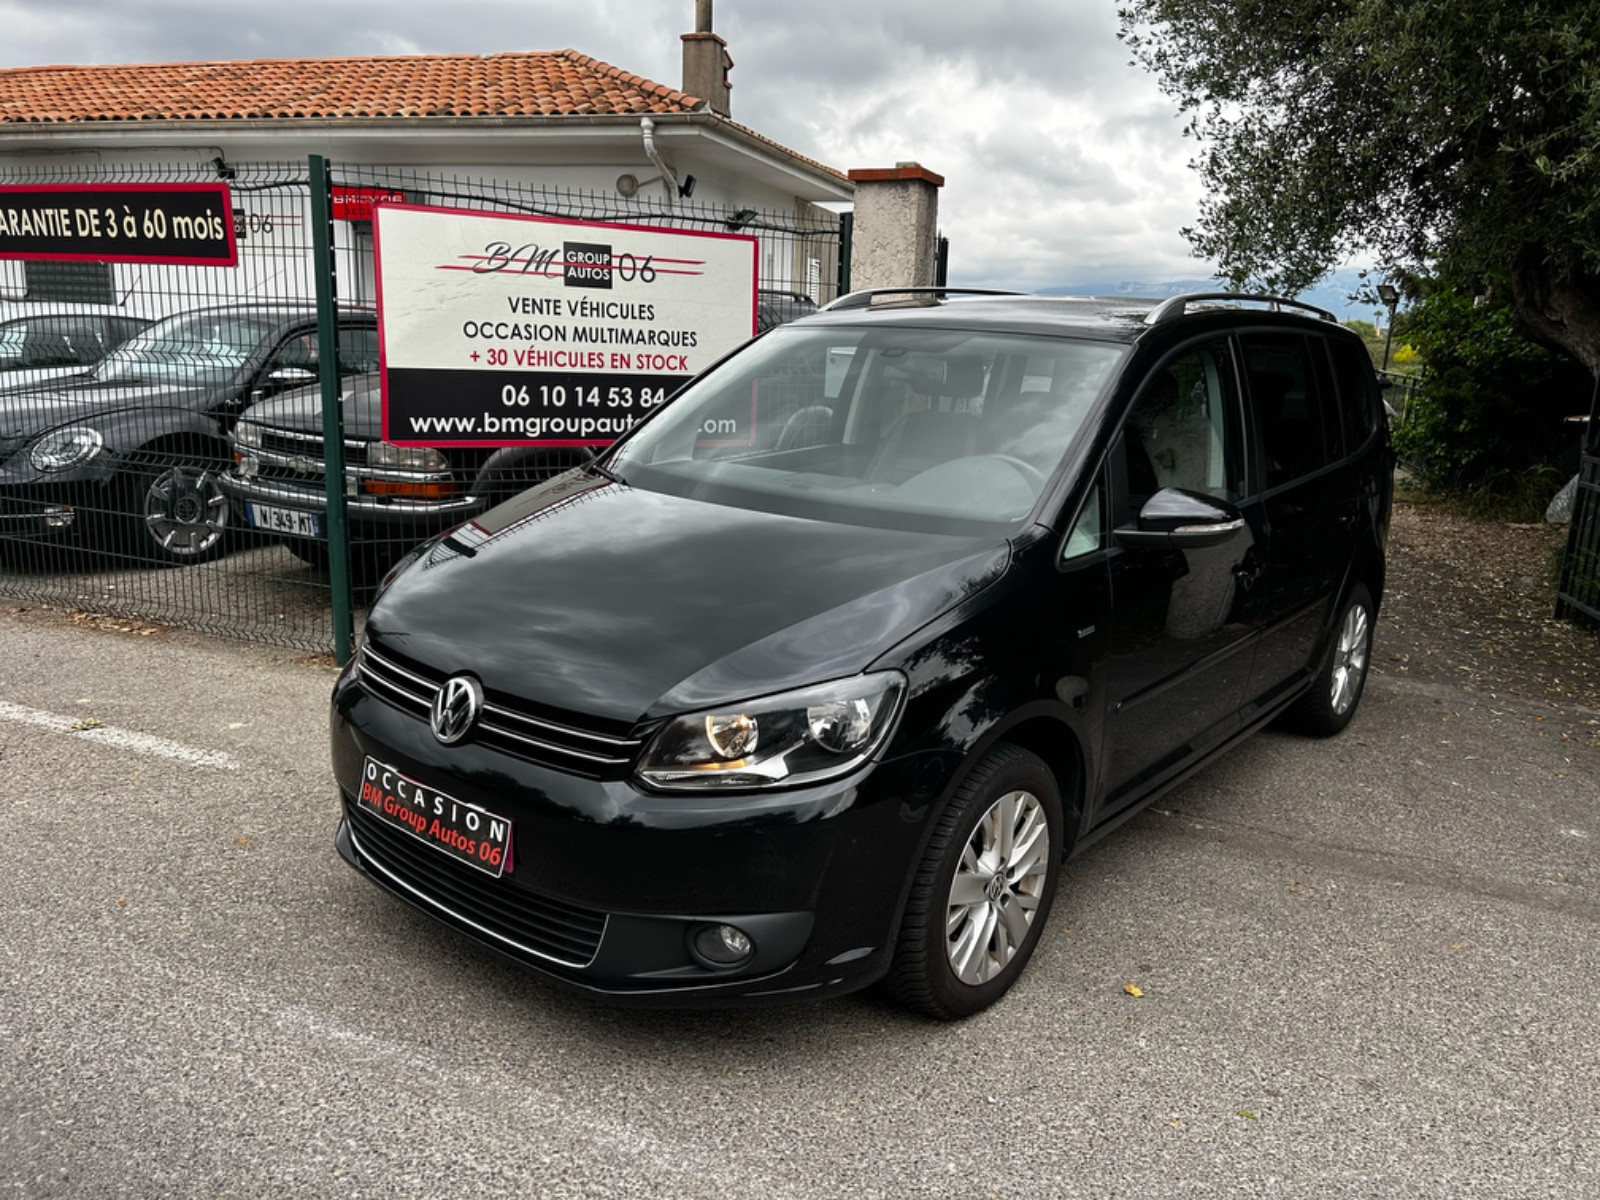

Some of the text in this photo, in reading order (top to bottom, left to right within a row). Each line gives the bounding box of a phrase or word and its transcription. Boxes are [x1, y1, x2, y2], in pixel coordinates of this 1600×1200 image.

[76, 208, 102, 238] DE
[104, 208, 119, 238] 3
[122, 205, 137, 238] à
[143, 208, 167, 239] 60
[172, 208, 224, 240] mois
[250, 213, 274, 234] 06
[472, 241, 657, 283] BM GROUP AUTOS 06
[507, 296, 655, 321] VENTE VÉHICULES
[463, 320, 698, 348] OCCASION MULTIMARQUES
[469, 345, 688, 371] + 30 VÉHICULES EN STOCK
[501, 384, 666, 408] 06 10 14 53 84
[366, 762, 505, 843] OCCASION
[362, 782, 502, 866] BM Group Autos 06
